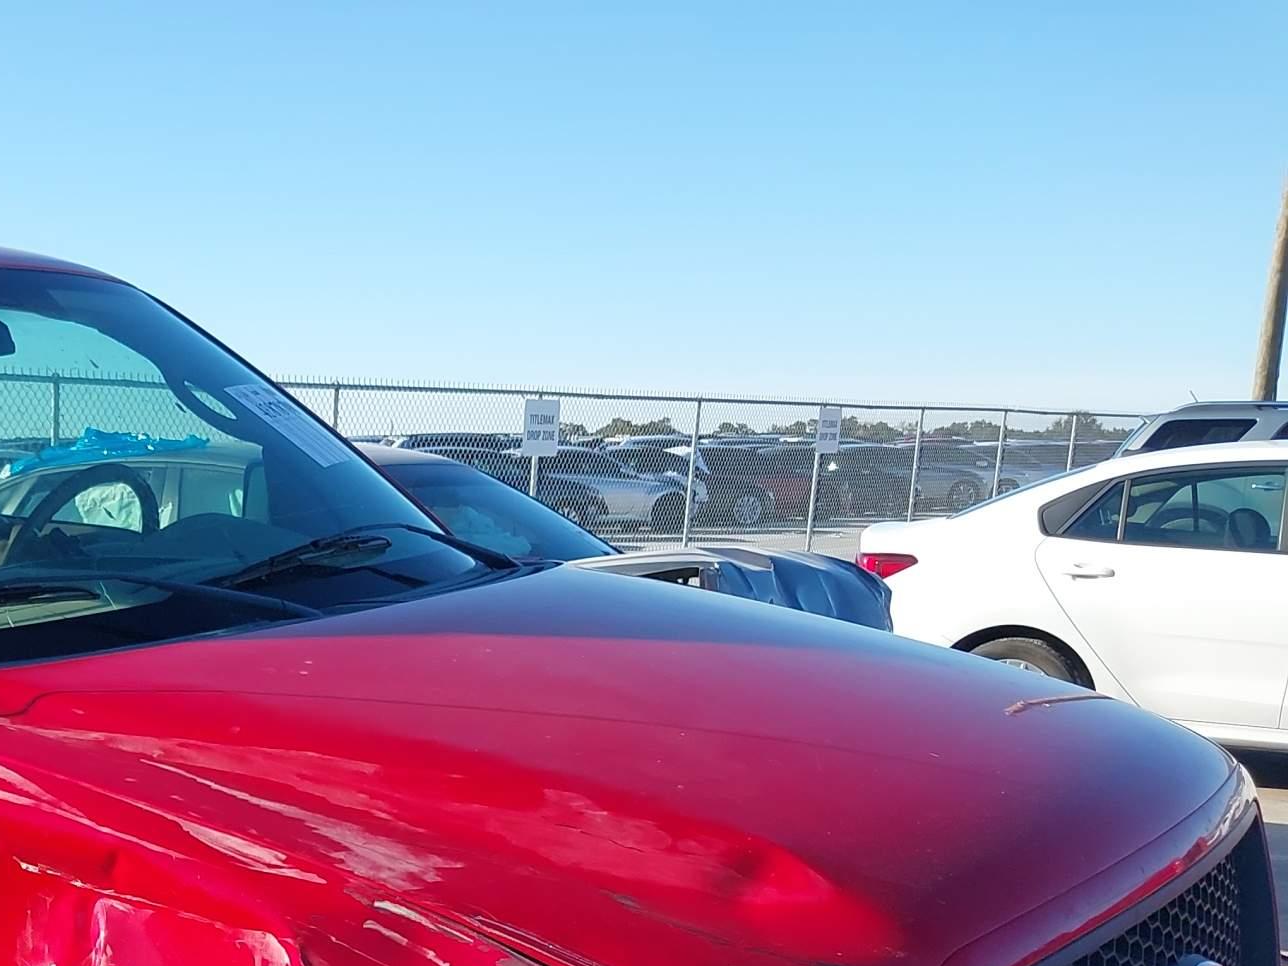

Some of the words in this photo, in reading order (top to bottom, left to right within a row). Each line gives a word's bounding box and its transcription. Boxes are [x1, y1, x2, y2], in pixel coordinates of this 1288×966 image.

[529, 414, 555, 425] TITLEMAX
[527, 430, 541, 441] DROP
[542, 430, 555, 441] ZONE
